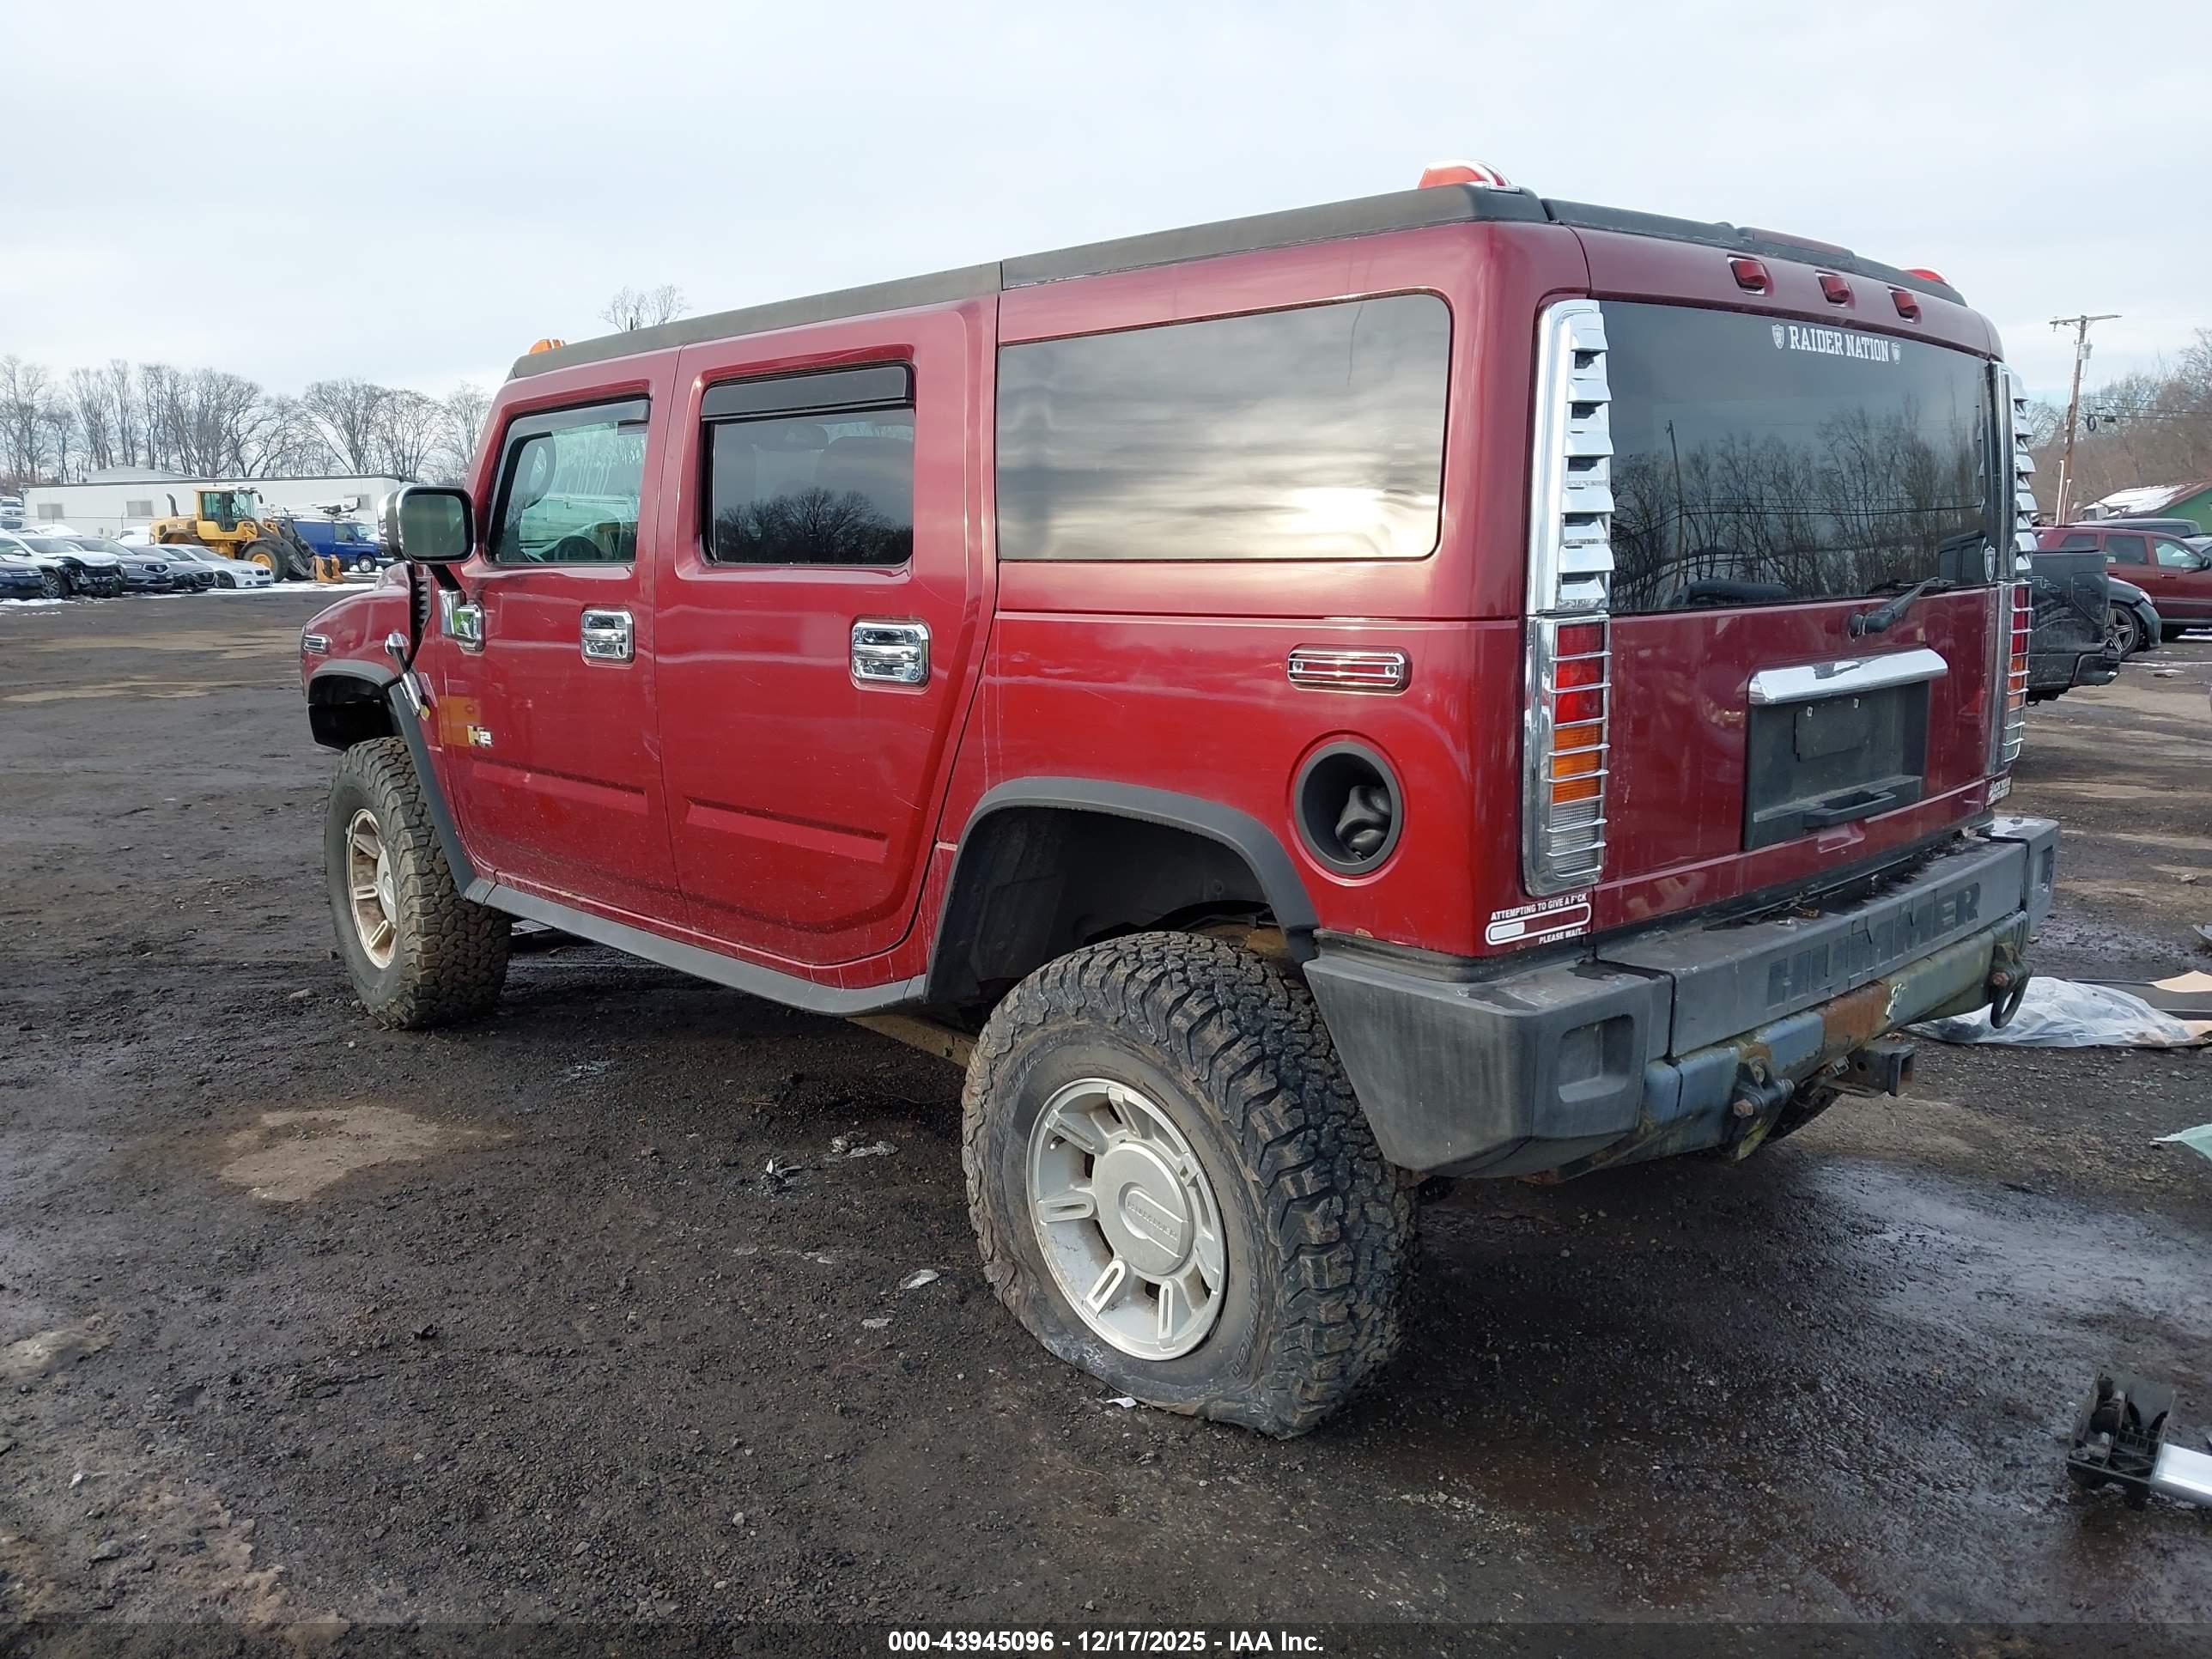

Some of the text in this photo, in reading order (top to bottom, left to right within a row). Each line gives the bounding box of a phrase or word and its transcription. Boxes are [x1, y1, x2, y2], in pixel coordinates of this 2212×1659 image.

[1789, 325, 1890, 362] RAIDER NATION
[466, 725, 492, 745] H2
[1491, 904, 1536, 921] ATTEMPTING
[1538, 902, 1547, 911] TO
[1548, 898, 1564, 909] GIVE
[1564, 896, 1571, 906] A
[1539, 932, 1565, 945] PLEASE
